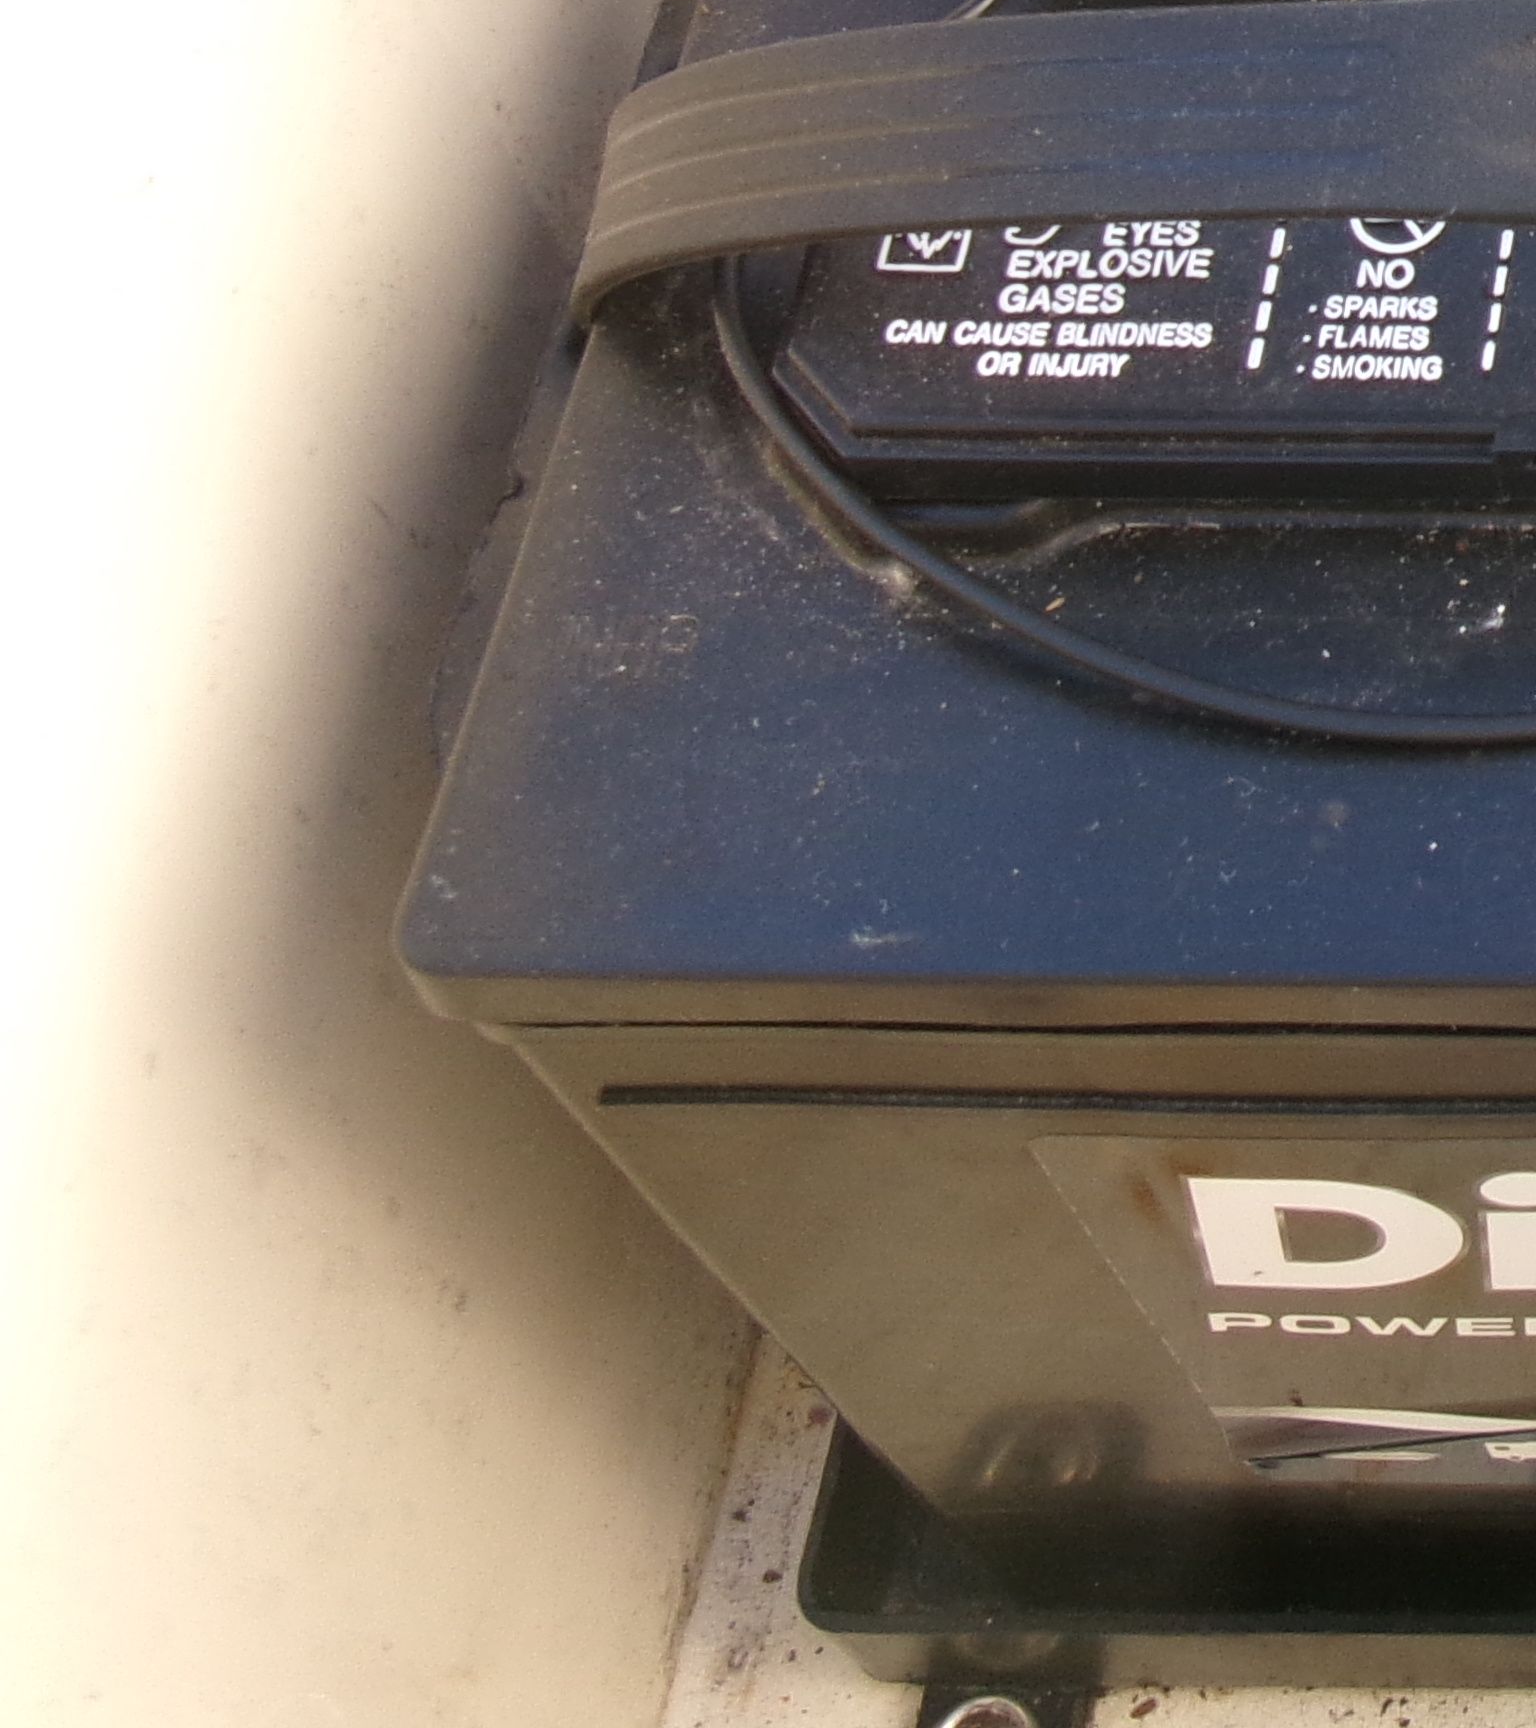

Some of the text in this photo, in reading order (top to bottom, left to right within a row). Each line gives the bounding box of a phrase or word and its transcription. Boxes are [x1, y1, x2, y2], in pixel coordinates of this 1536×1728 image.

[1103, 221, 1201, 247] EYES
[1006, 249, 1214, 279] EXPLOSIVE
[1357, 258, 1415, 289] NO
[999, 284, 1126, 314] GASES
[1323, 296, 1438, 321] SPARKS
[885, 319, 1213, 348] CAN CAUSE BLINDNESS
[1318, 326, 1430, 350] FLAMES
[977, 352, 1131, 378] OR INJURY
[1311, 355, 1443, 381] SMOKING
